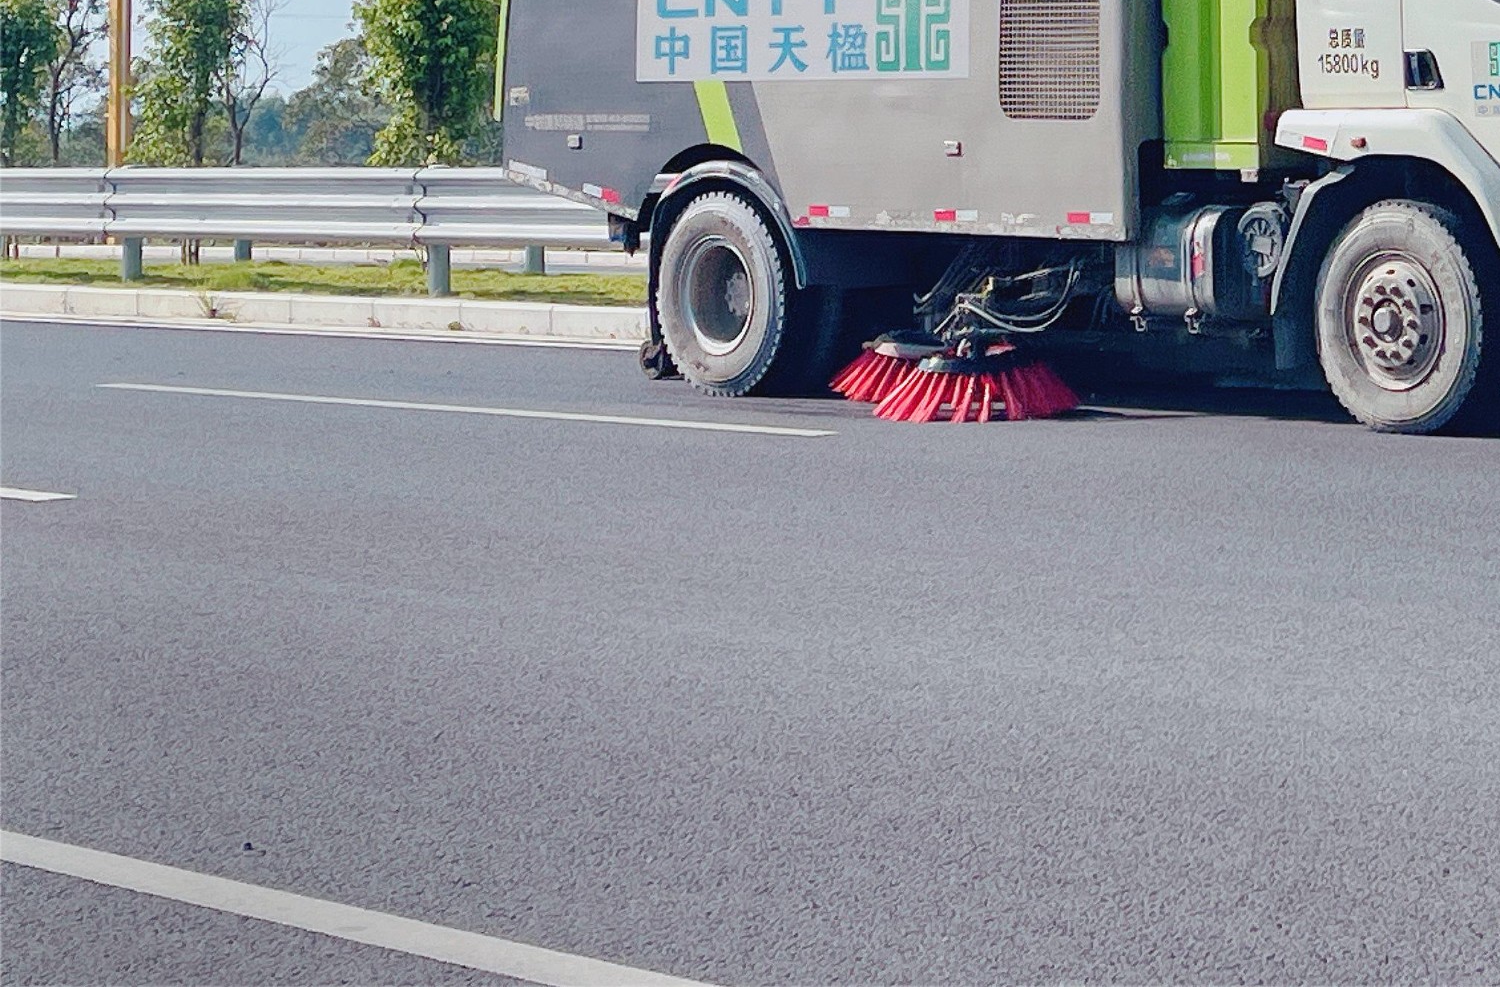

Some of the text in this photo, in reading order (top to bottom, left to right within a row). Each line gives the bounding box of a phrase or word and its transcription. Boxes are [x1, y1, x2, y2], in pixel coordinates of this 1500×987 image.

[654, 22, 870, 75] 中国天楹
[1328, 28, 1365, 49] 总质量
[1317, 53, 1379, 79] 15800kg
